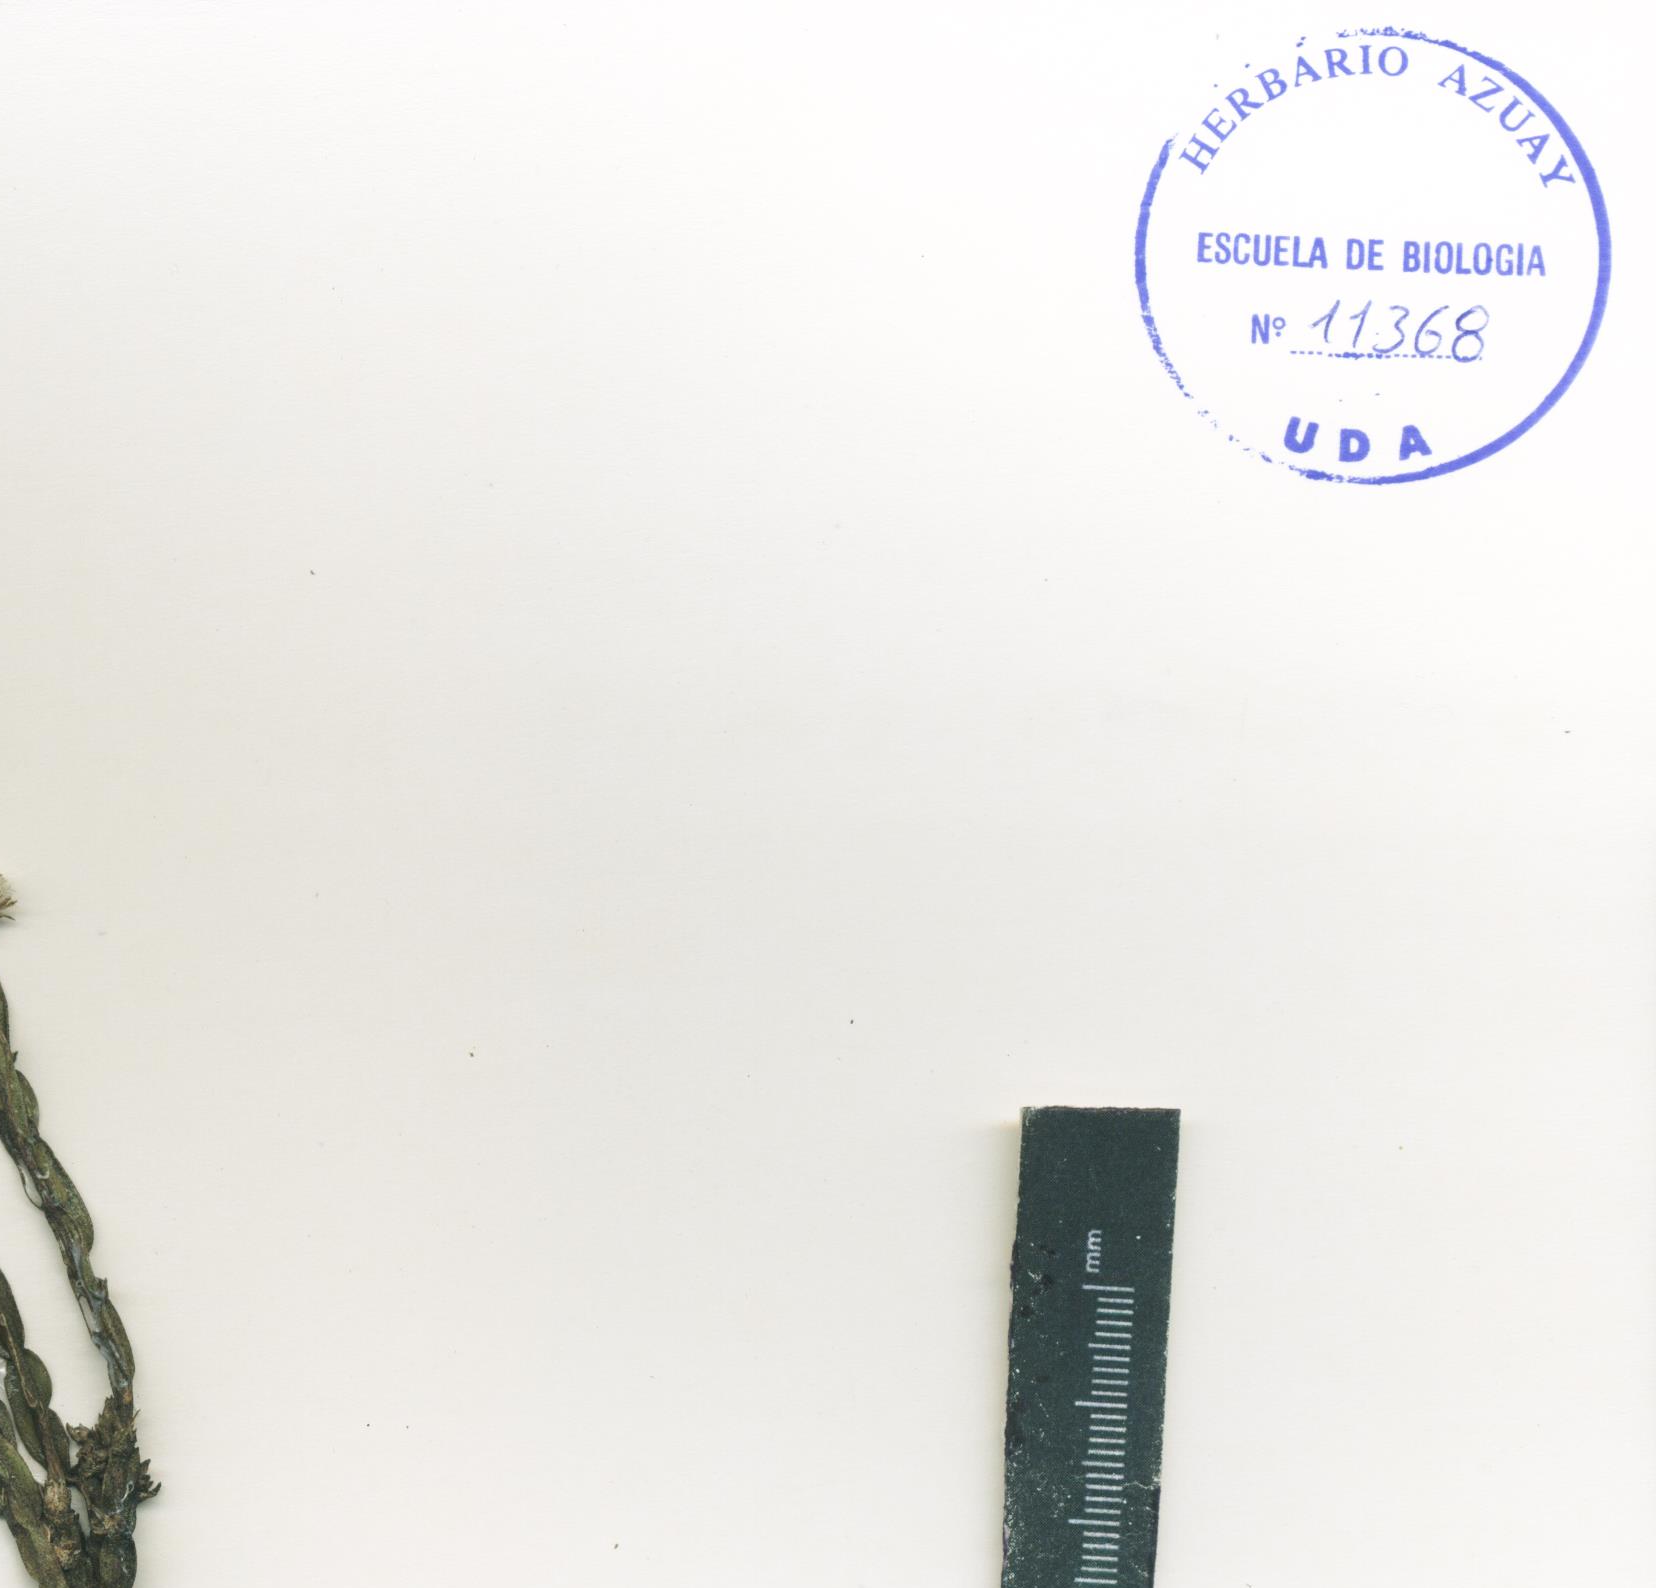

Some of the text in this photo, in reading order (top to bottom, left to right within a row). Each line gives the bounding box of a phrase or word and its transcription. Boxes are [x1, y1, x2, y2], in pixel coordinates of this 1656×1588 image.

[1179, 45, 1576, 188] HERBARIO AZUAY
[1197, 232, 1546, 276] ESCUELA DE BIOLOGIA
[1309, 300, 1489, 362] 11368
[1086, 1229, 1102, 1273] mm
